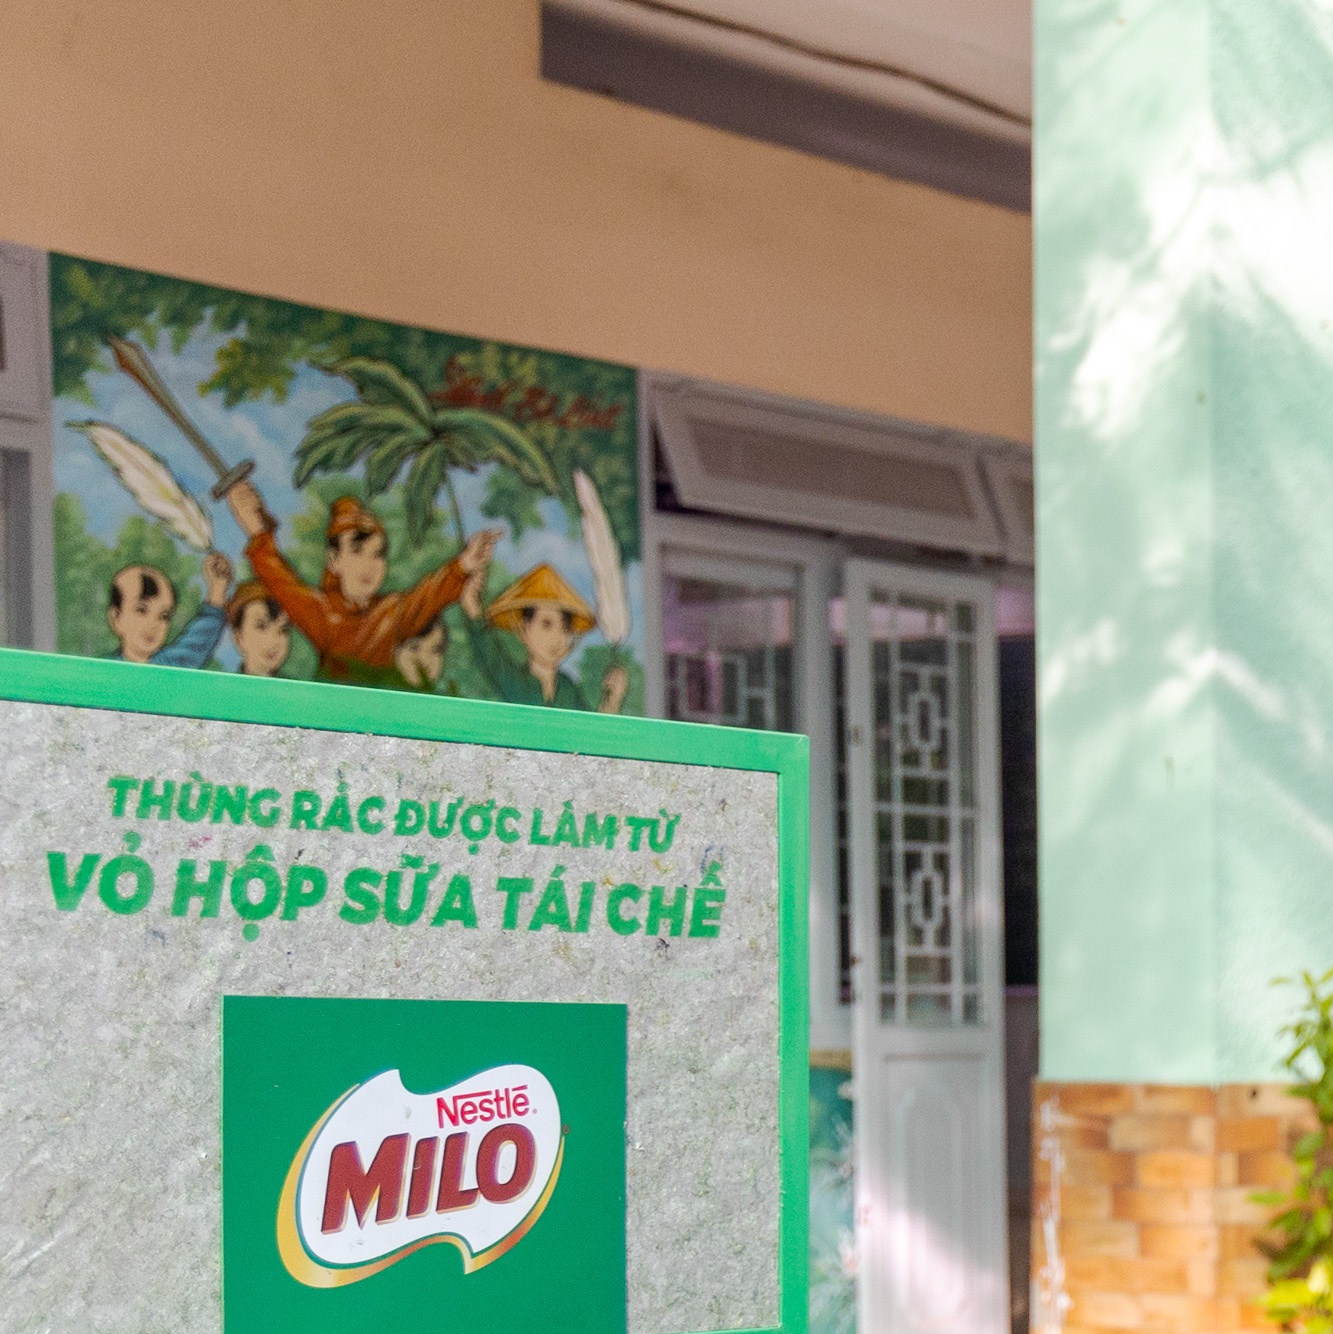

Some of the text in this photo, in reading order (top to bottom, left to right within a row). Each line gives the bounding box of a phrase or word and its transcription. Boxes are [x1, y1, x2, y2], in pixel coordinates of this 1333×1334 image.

[107, 771, 682, 855] THÙNG RÁC ĐƯỢC LÀM TỪ
[47, 831, 727, 942] VỎ HỘP SỮA TÁI CHẾ
[321, 1123, 538, 1235] MILO
